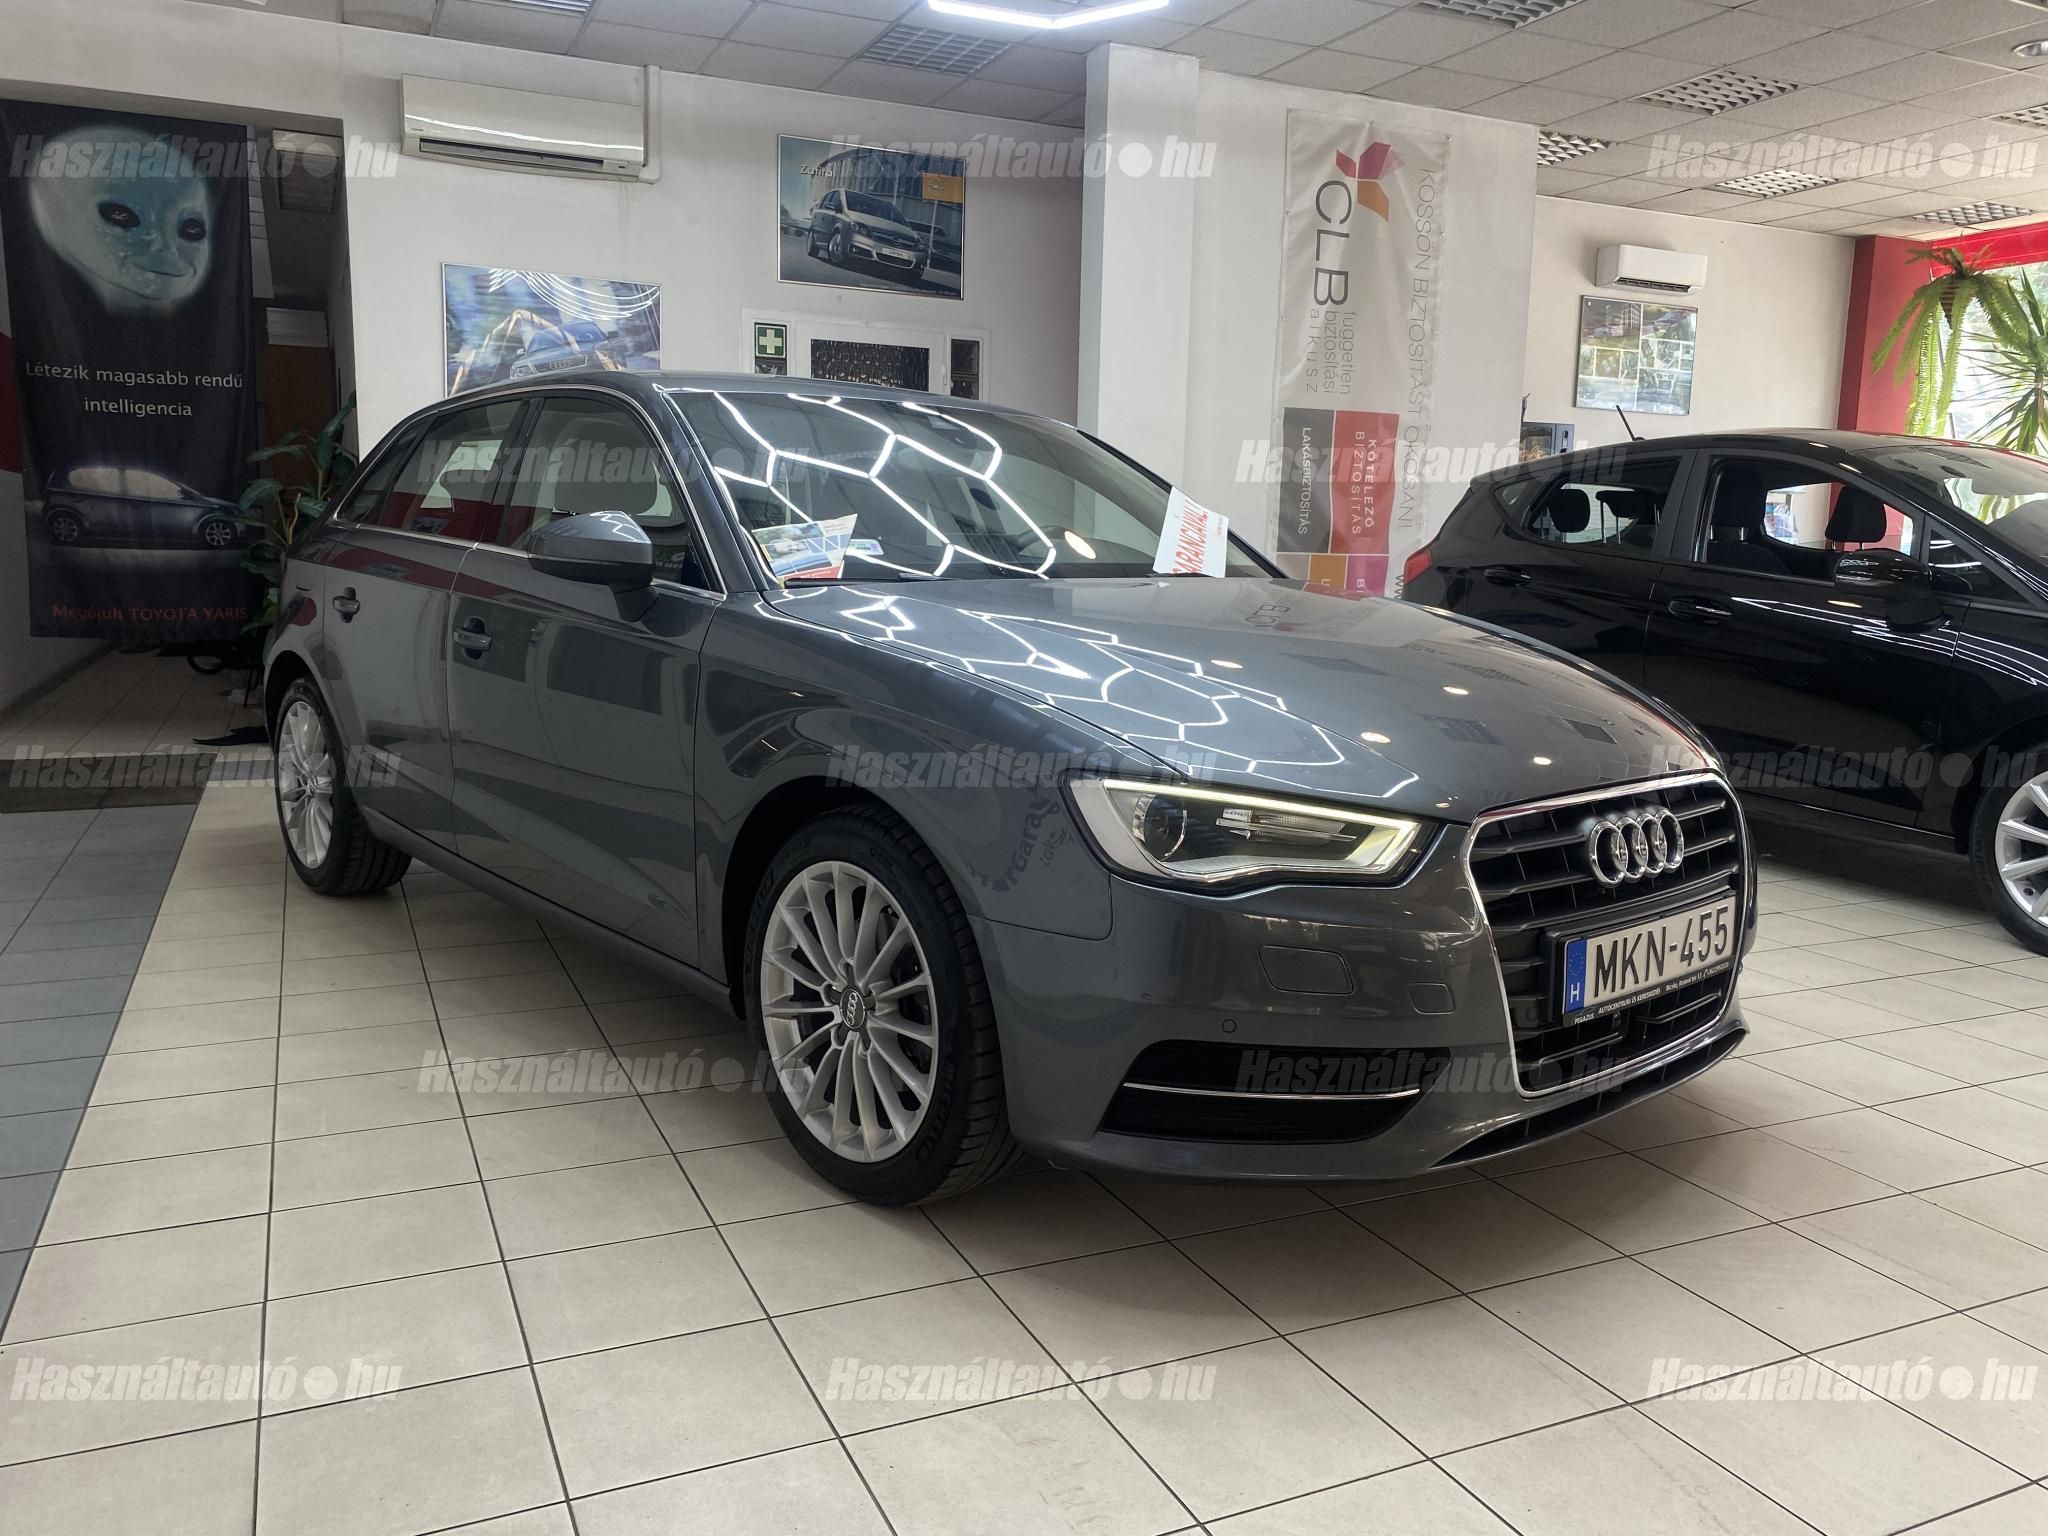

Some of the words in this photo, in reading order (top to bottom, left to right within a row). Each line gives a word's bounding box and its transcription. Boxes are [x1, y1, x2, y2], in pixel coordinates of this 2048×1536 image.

[1414, 168, 1438, 271] KÖSSÖN
[1313, 180, 1352, 306] CLB
[26, 361, 90, 380] Létezik
[96, 369, 189, 387] magasabb
[84, 397, 193, 417] intelligencia
[128, 607, 198, 621] TOYOTA
[203, 607, 248, 620] YARIS
[1594, 904, 1729, 998] MKN-455
[1570, 982, 1580, 1003] H
